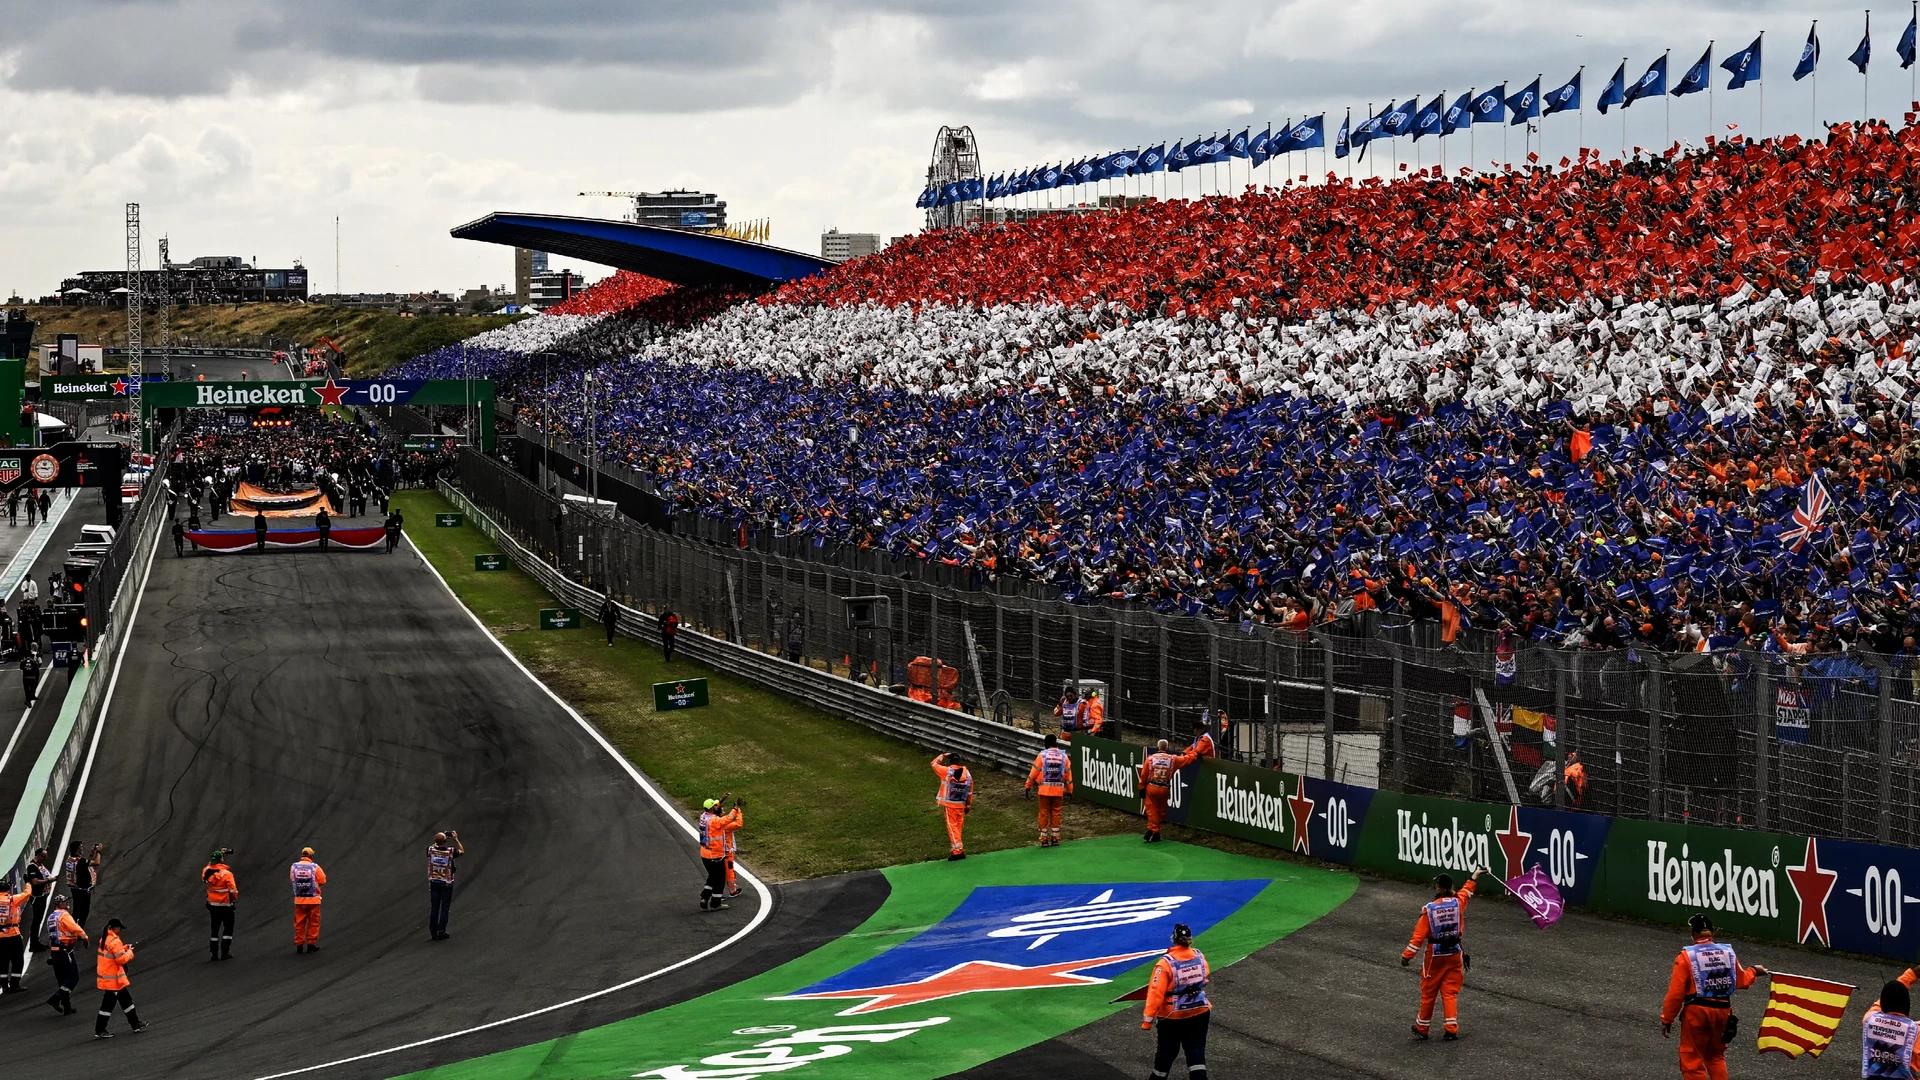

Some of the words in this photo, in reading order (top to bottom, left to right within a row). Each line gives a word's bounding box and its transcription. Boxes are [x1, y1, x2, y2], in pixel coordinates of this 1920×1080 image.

[53, 383, 107, 393] Heineken
[196, 384, 305, 404] Heineken
[369, 384, 396, 403] 0.0
[228, 415, 245, 426] FIA
[0, 460, 18, 468] AG
[1081, 746, 1134, 798] Heineken
[1216, 772, 1285, 833] Heineken
[1327, 796, 1348, 848] 0.0
[1397, 809, 1491, 873] Heineken
[1550, 828, 1576, 888] 0.0
[1647, 840, 1780, 919] Heineken
[1864, 865, 1902, 937] 0.0
[1703, 976, 1732, 987] COURSE
[1872, 1031, 1897, 1041] MARSHAL
[1869, 1048, 1902, 1063] COURSE
